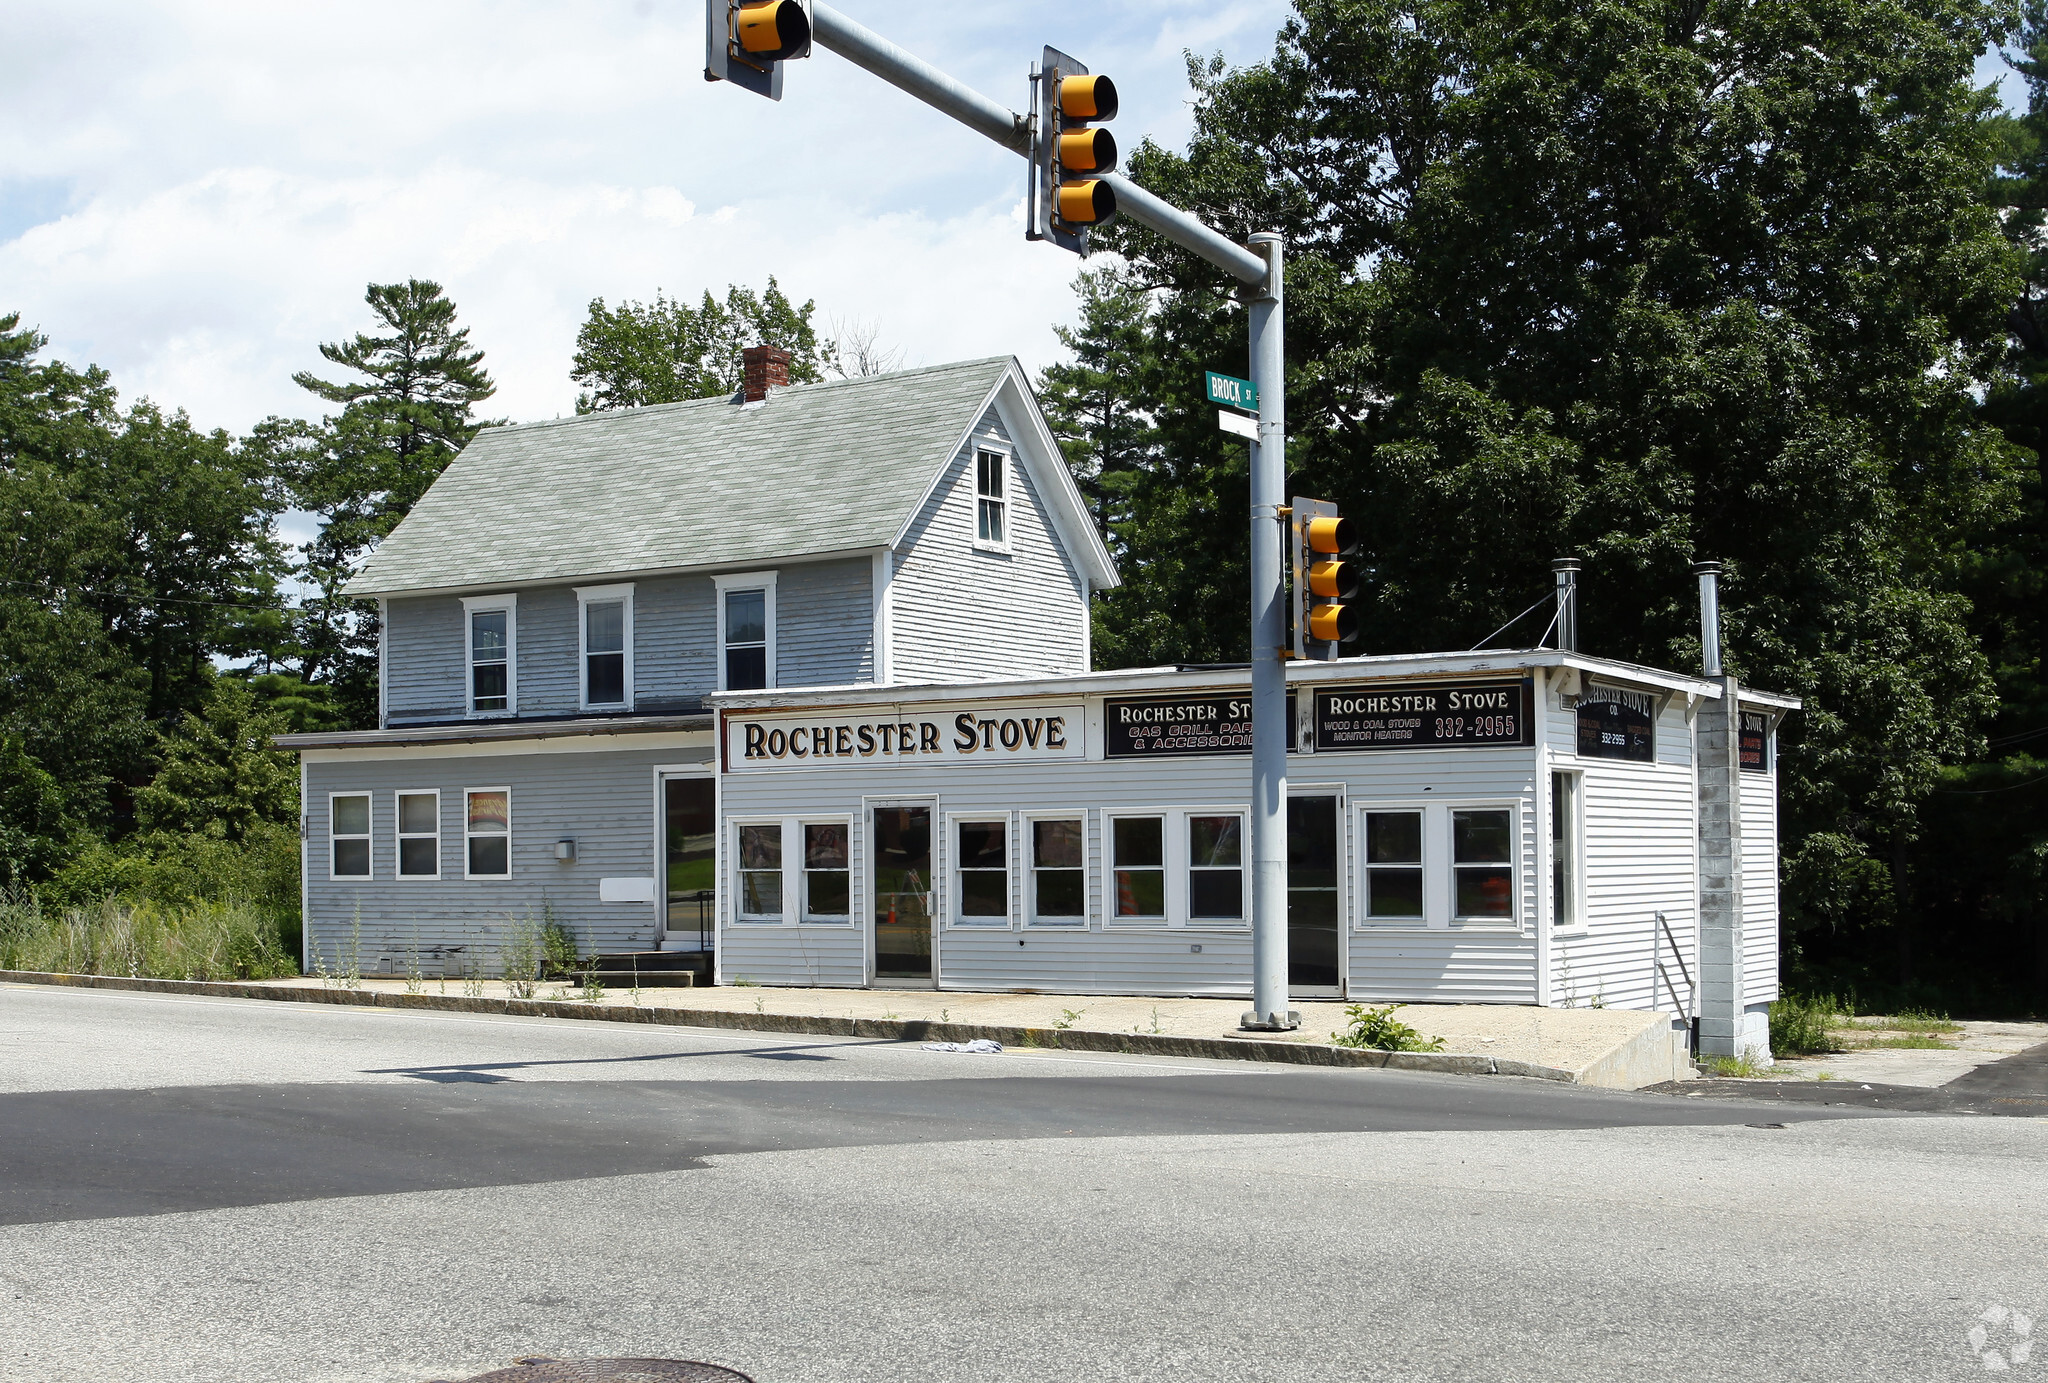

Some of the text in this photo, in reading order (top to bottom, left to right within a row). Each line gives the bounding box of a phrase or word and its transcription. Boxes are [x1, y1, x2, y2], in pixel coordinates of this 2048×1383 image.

[1211, 376, 1252, 403] BROCK ST
[1329, 691, 1509, 715] ROCHESTER STOVE
[1623, 690, 1649, 718] STOVE
[1120, 705, 1218, 724] ROCHESTER
[1129, 722, 1253, 738] GAS GRILL PAR
[1324, 718, 1421, 731] WOOD & COAL STOVES
[1435, 715, 1515, 738] 332-2955
[744, 712, 1067, 761] ROCHESTER STOVE
[1133, 735, 1253, 750] & ACCESSORI
[1333, 729, 1413, 742] MONITOR HEATERS
[1601, 732, 1626, 746] 332-2955
